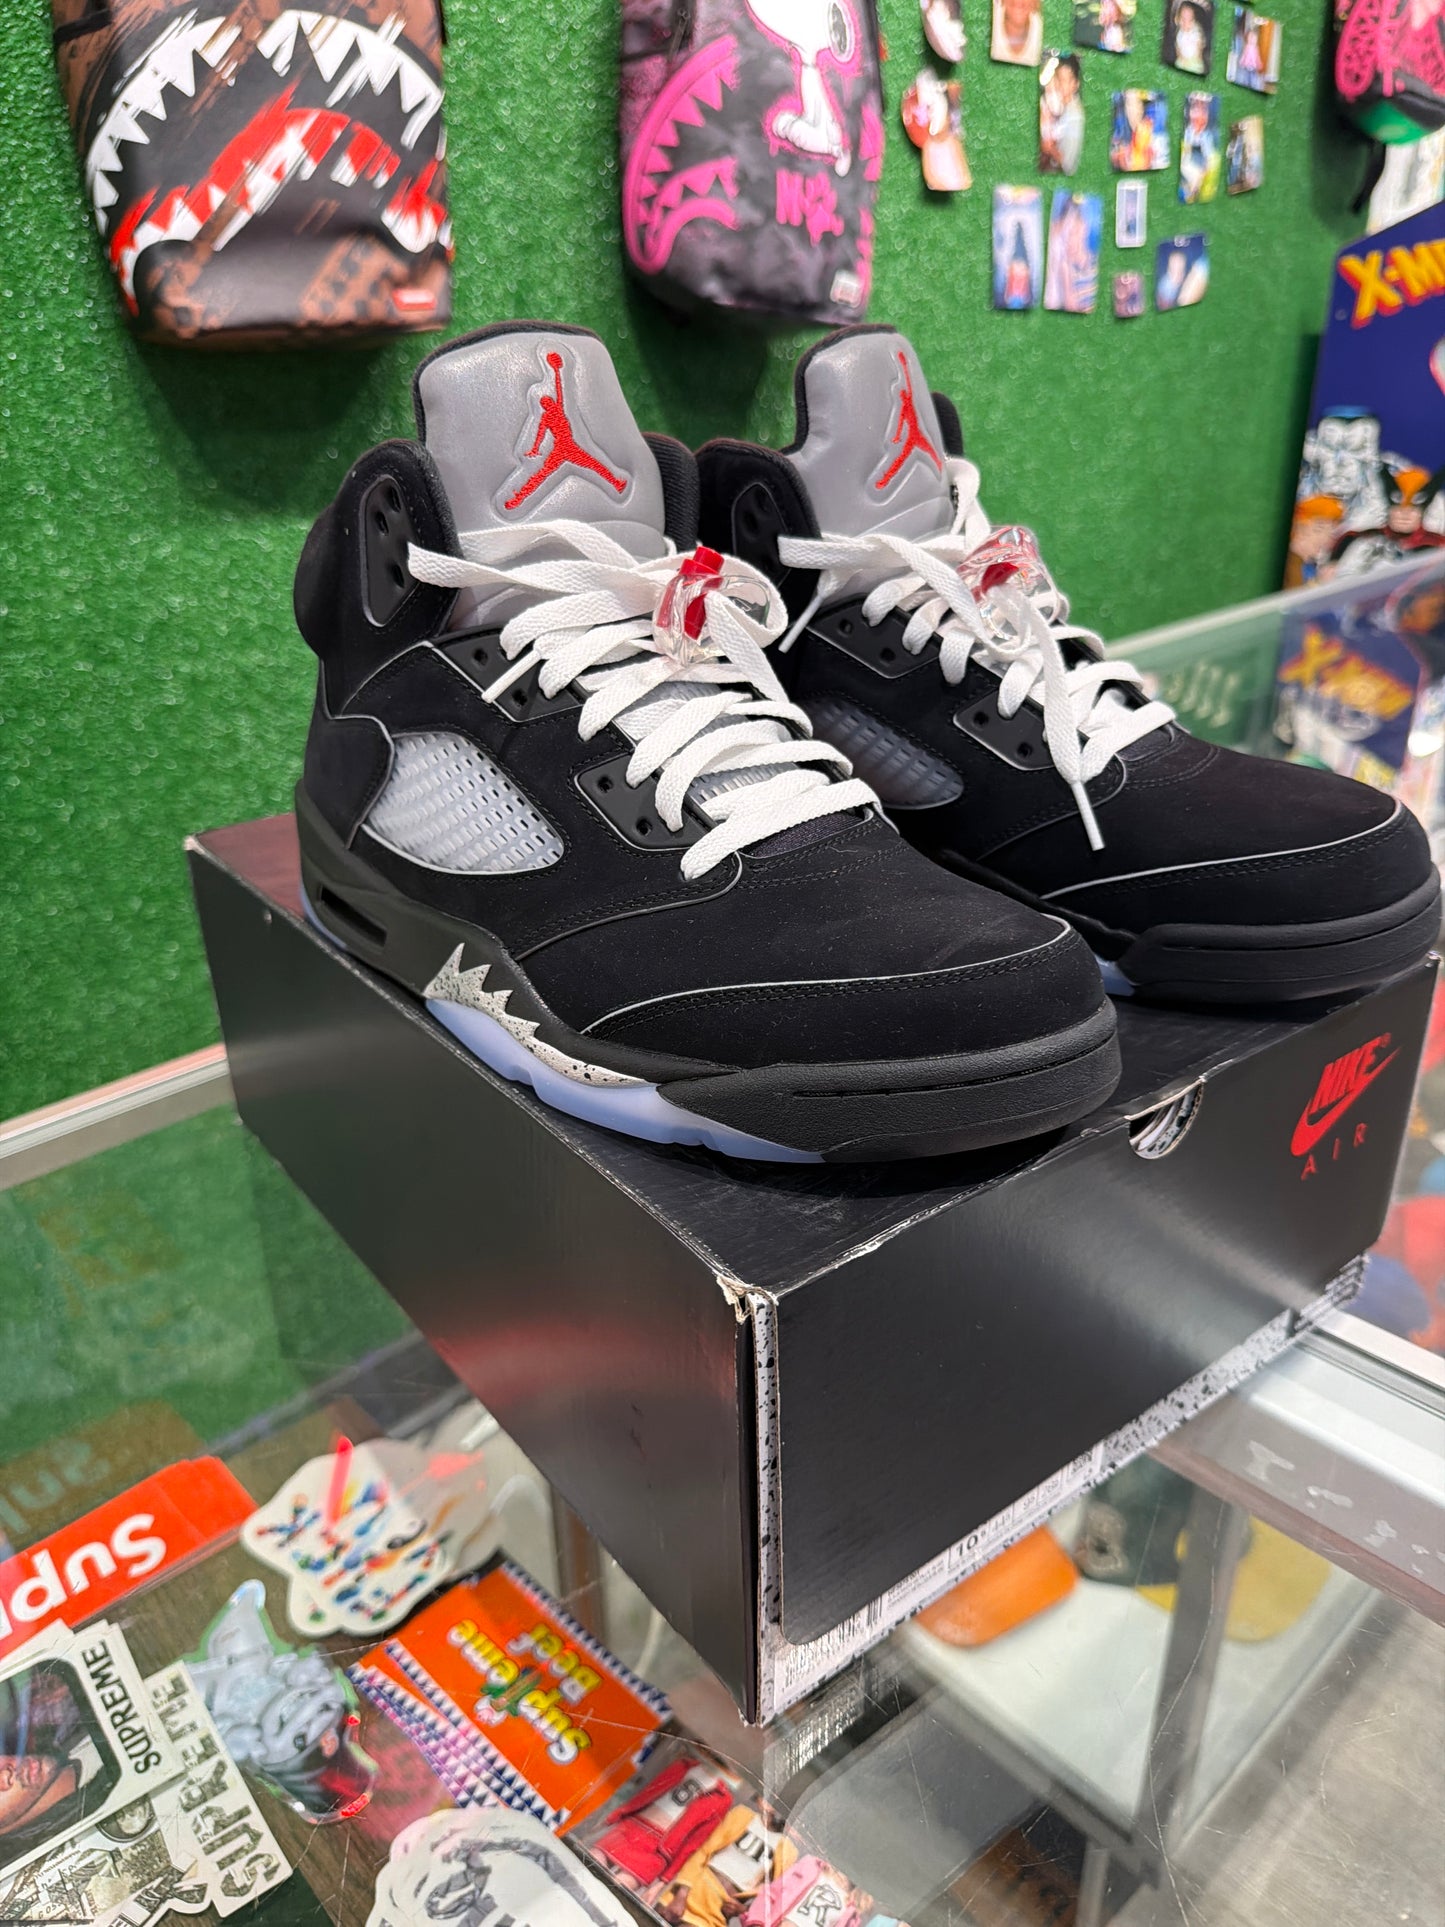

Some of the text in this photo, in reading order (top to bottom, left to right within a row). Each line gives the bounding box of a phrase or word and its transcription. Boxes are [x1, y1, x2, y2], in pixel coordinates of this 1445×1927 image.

[1308, 1035, 1383, 1116] NIKE
[1301, 1122, 1368, 1180] AIR
[506, 1622, 603, 1706] Beef
[82, 1640, 162, 1774] SUPREME
[151, 1671, 281, 1897] SUPREME
